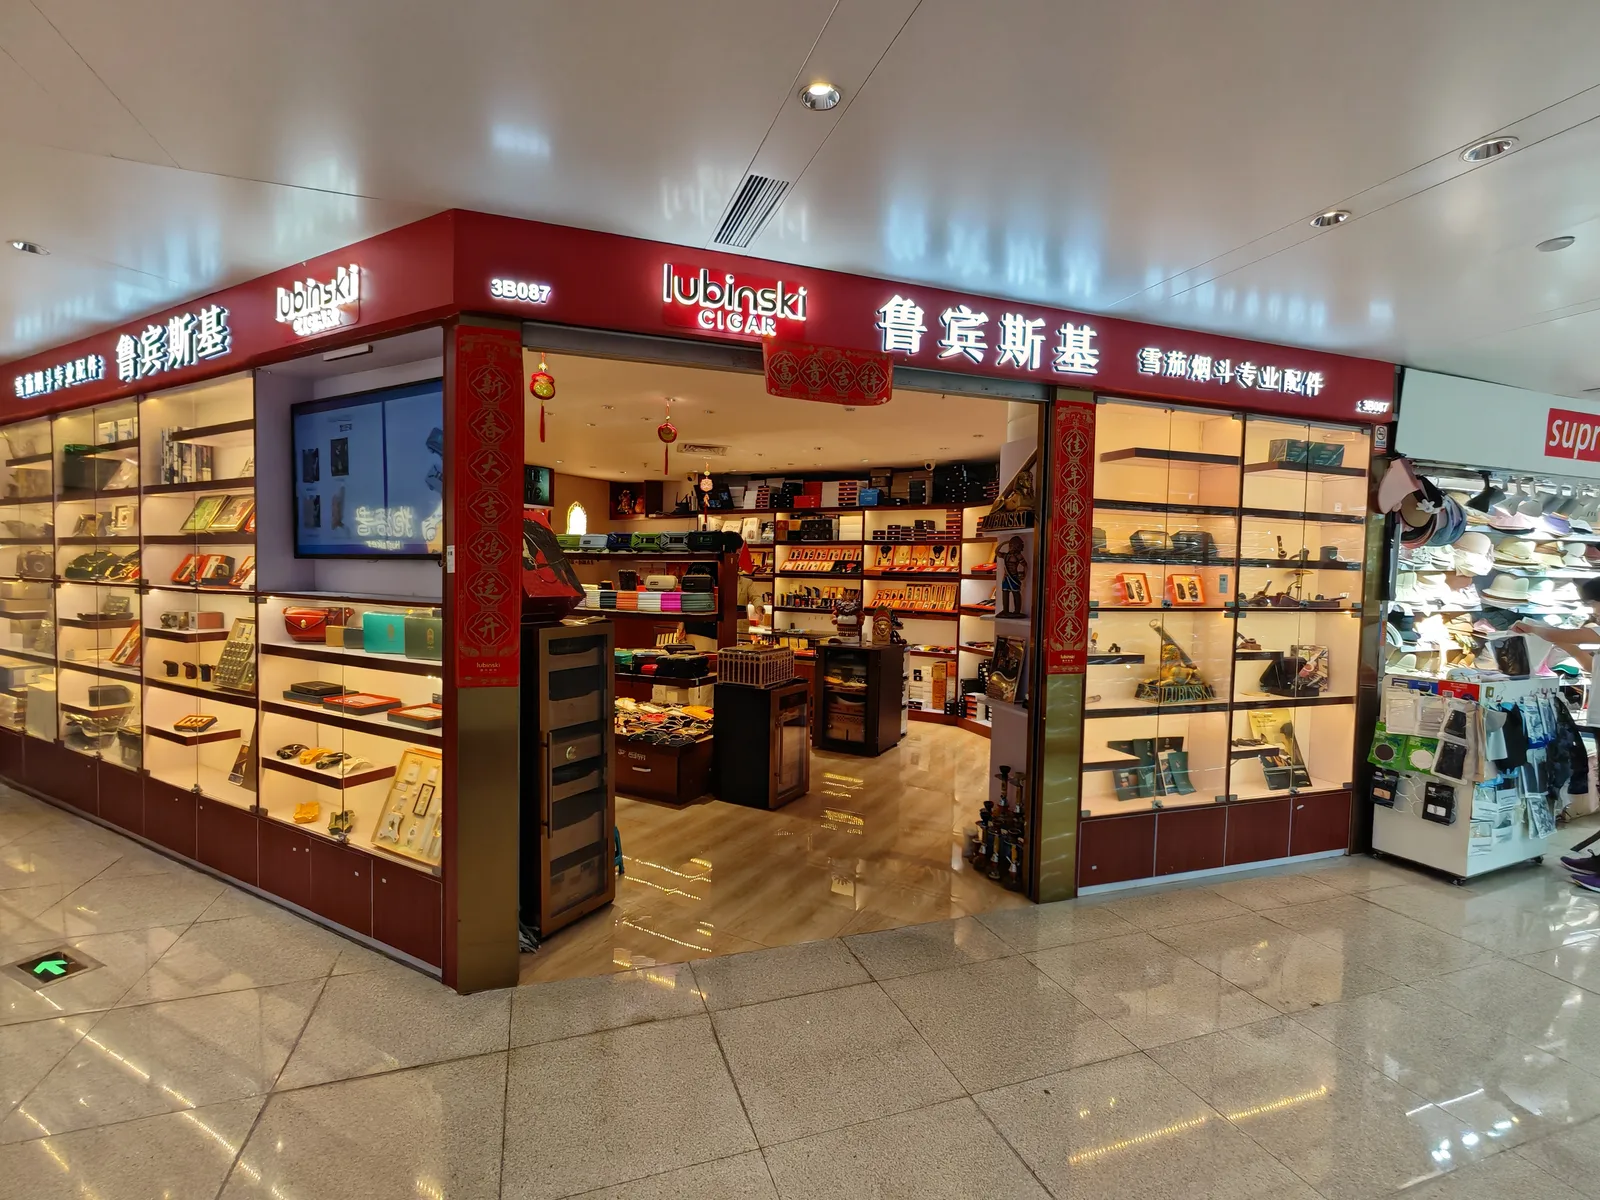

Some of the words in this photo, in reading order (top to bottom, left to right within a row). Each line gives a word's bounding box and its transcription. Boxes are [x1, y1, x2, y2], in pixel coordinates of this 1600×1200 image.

[276, 264, 359, 322] lubinski
[490, 278, 551, 304] 3B087
[662, 263, 807, 321] lubinski
[116, 304, 231, 382] 鲁宾斯基
[698, 309, 777, 337] CIGAR
[876, 294, 1100, 375] 鲁宾斯基
[776, 359, 882, 394] 富贵吉祥
[1137, 347, 1324, 397] 雪茄烟斗专业配件
[1549, 419, 1600, 459] supr
